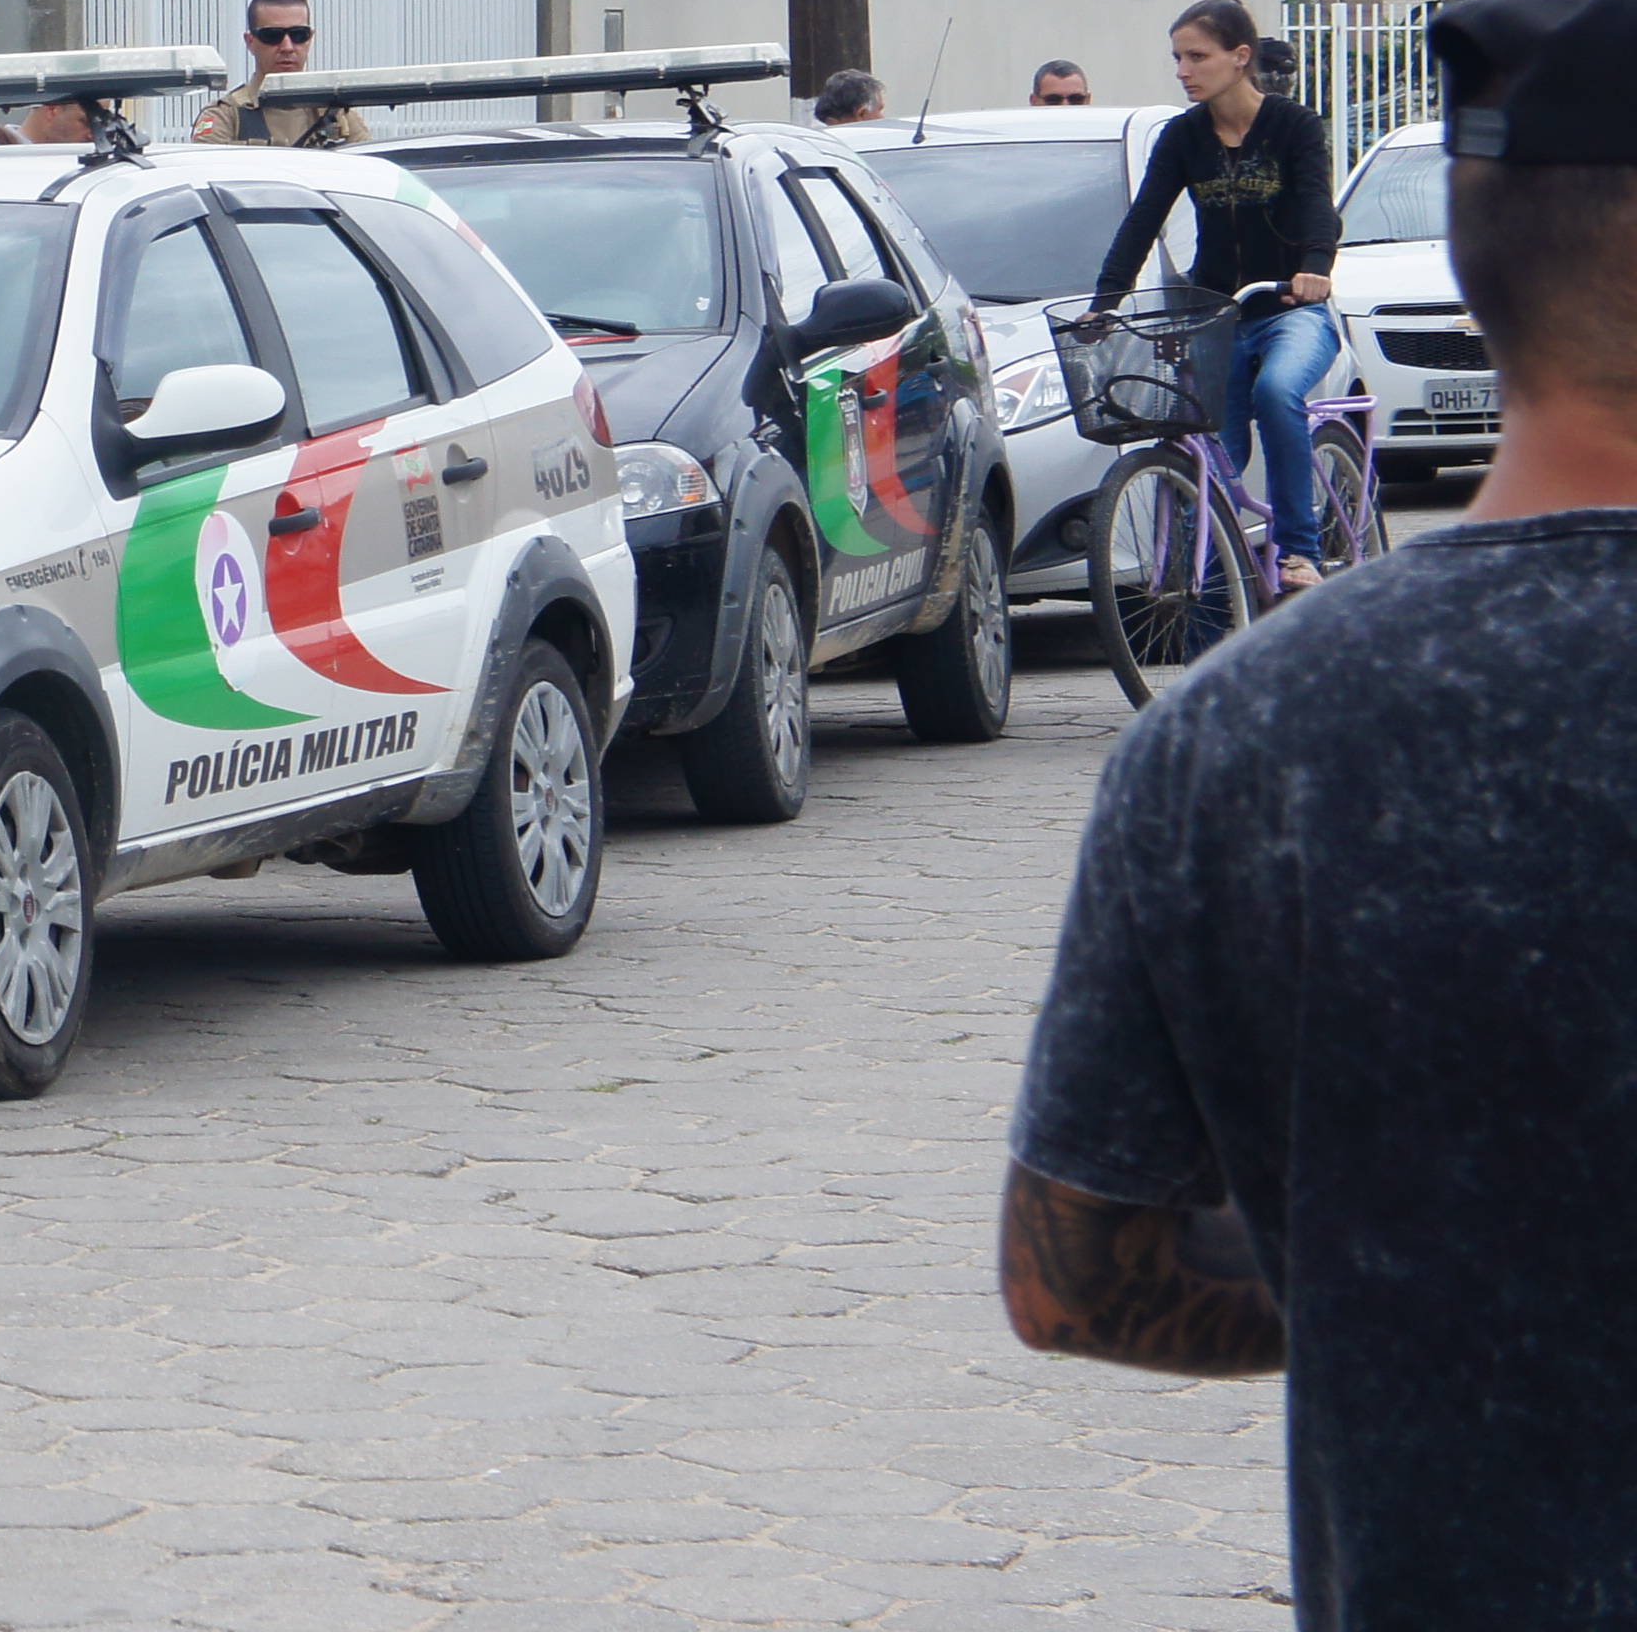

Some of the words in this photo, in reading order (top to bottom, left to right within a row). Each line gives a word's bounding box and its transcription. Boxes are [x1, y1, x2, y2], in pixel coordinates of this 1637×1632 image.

[404, 495, 438, 519] GOVERNO
[406, 519, 418, 540] DE
[418, 513, 441, 536] SANTA
[408, 532, 443, 557] CATARINA
[6, 561, 77, 592] EMERGÊNCIA
[91, 549, 111, 567] 190
[887, 546, 927, 596] CIVIL
[164, 737, 292, 805] POLÍCIA
[298, 710, 419, 775] MILITAR
